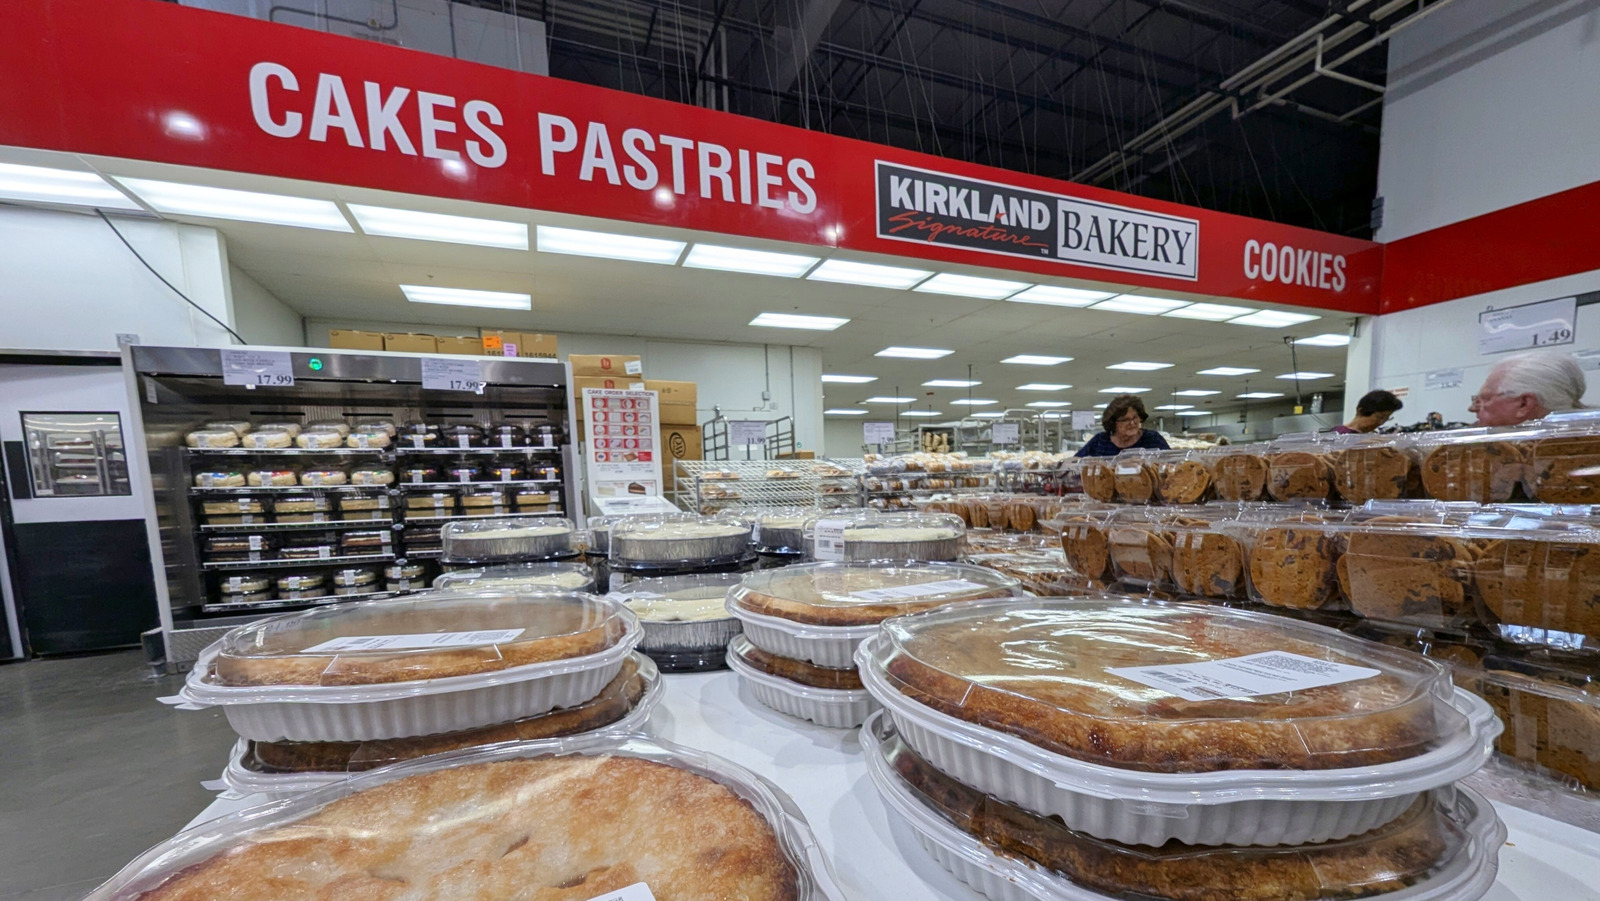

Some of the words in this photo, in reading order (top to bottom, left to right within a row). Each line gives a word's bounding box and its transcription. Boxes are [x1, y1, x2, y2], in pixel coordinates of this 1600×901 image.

[248, 61, 508, 169] CAKES
[537, 112, 817, 214] PASTRIES
[890, 175, 1051, 231] KIRKLAND
[888, 210, 1049, 242] Signature
[1061, 209, 1192, 266] BAKERY
[1243, 239, 1347, 292] COOKIES
[1532, 329, 1571, 346] 1.49
[257, 374, 292, 385] 17.99
[449, 380, 479, 390] 17.99
